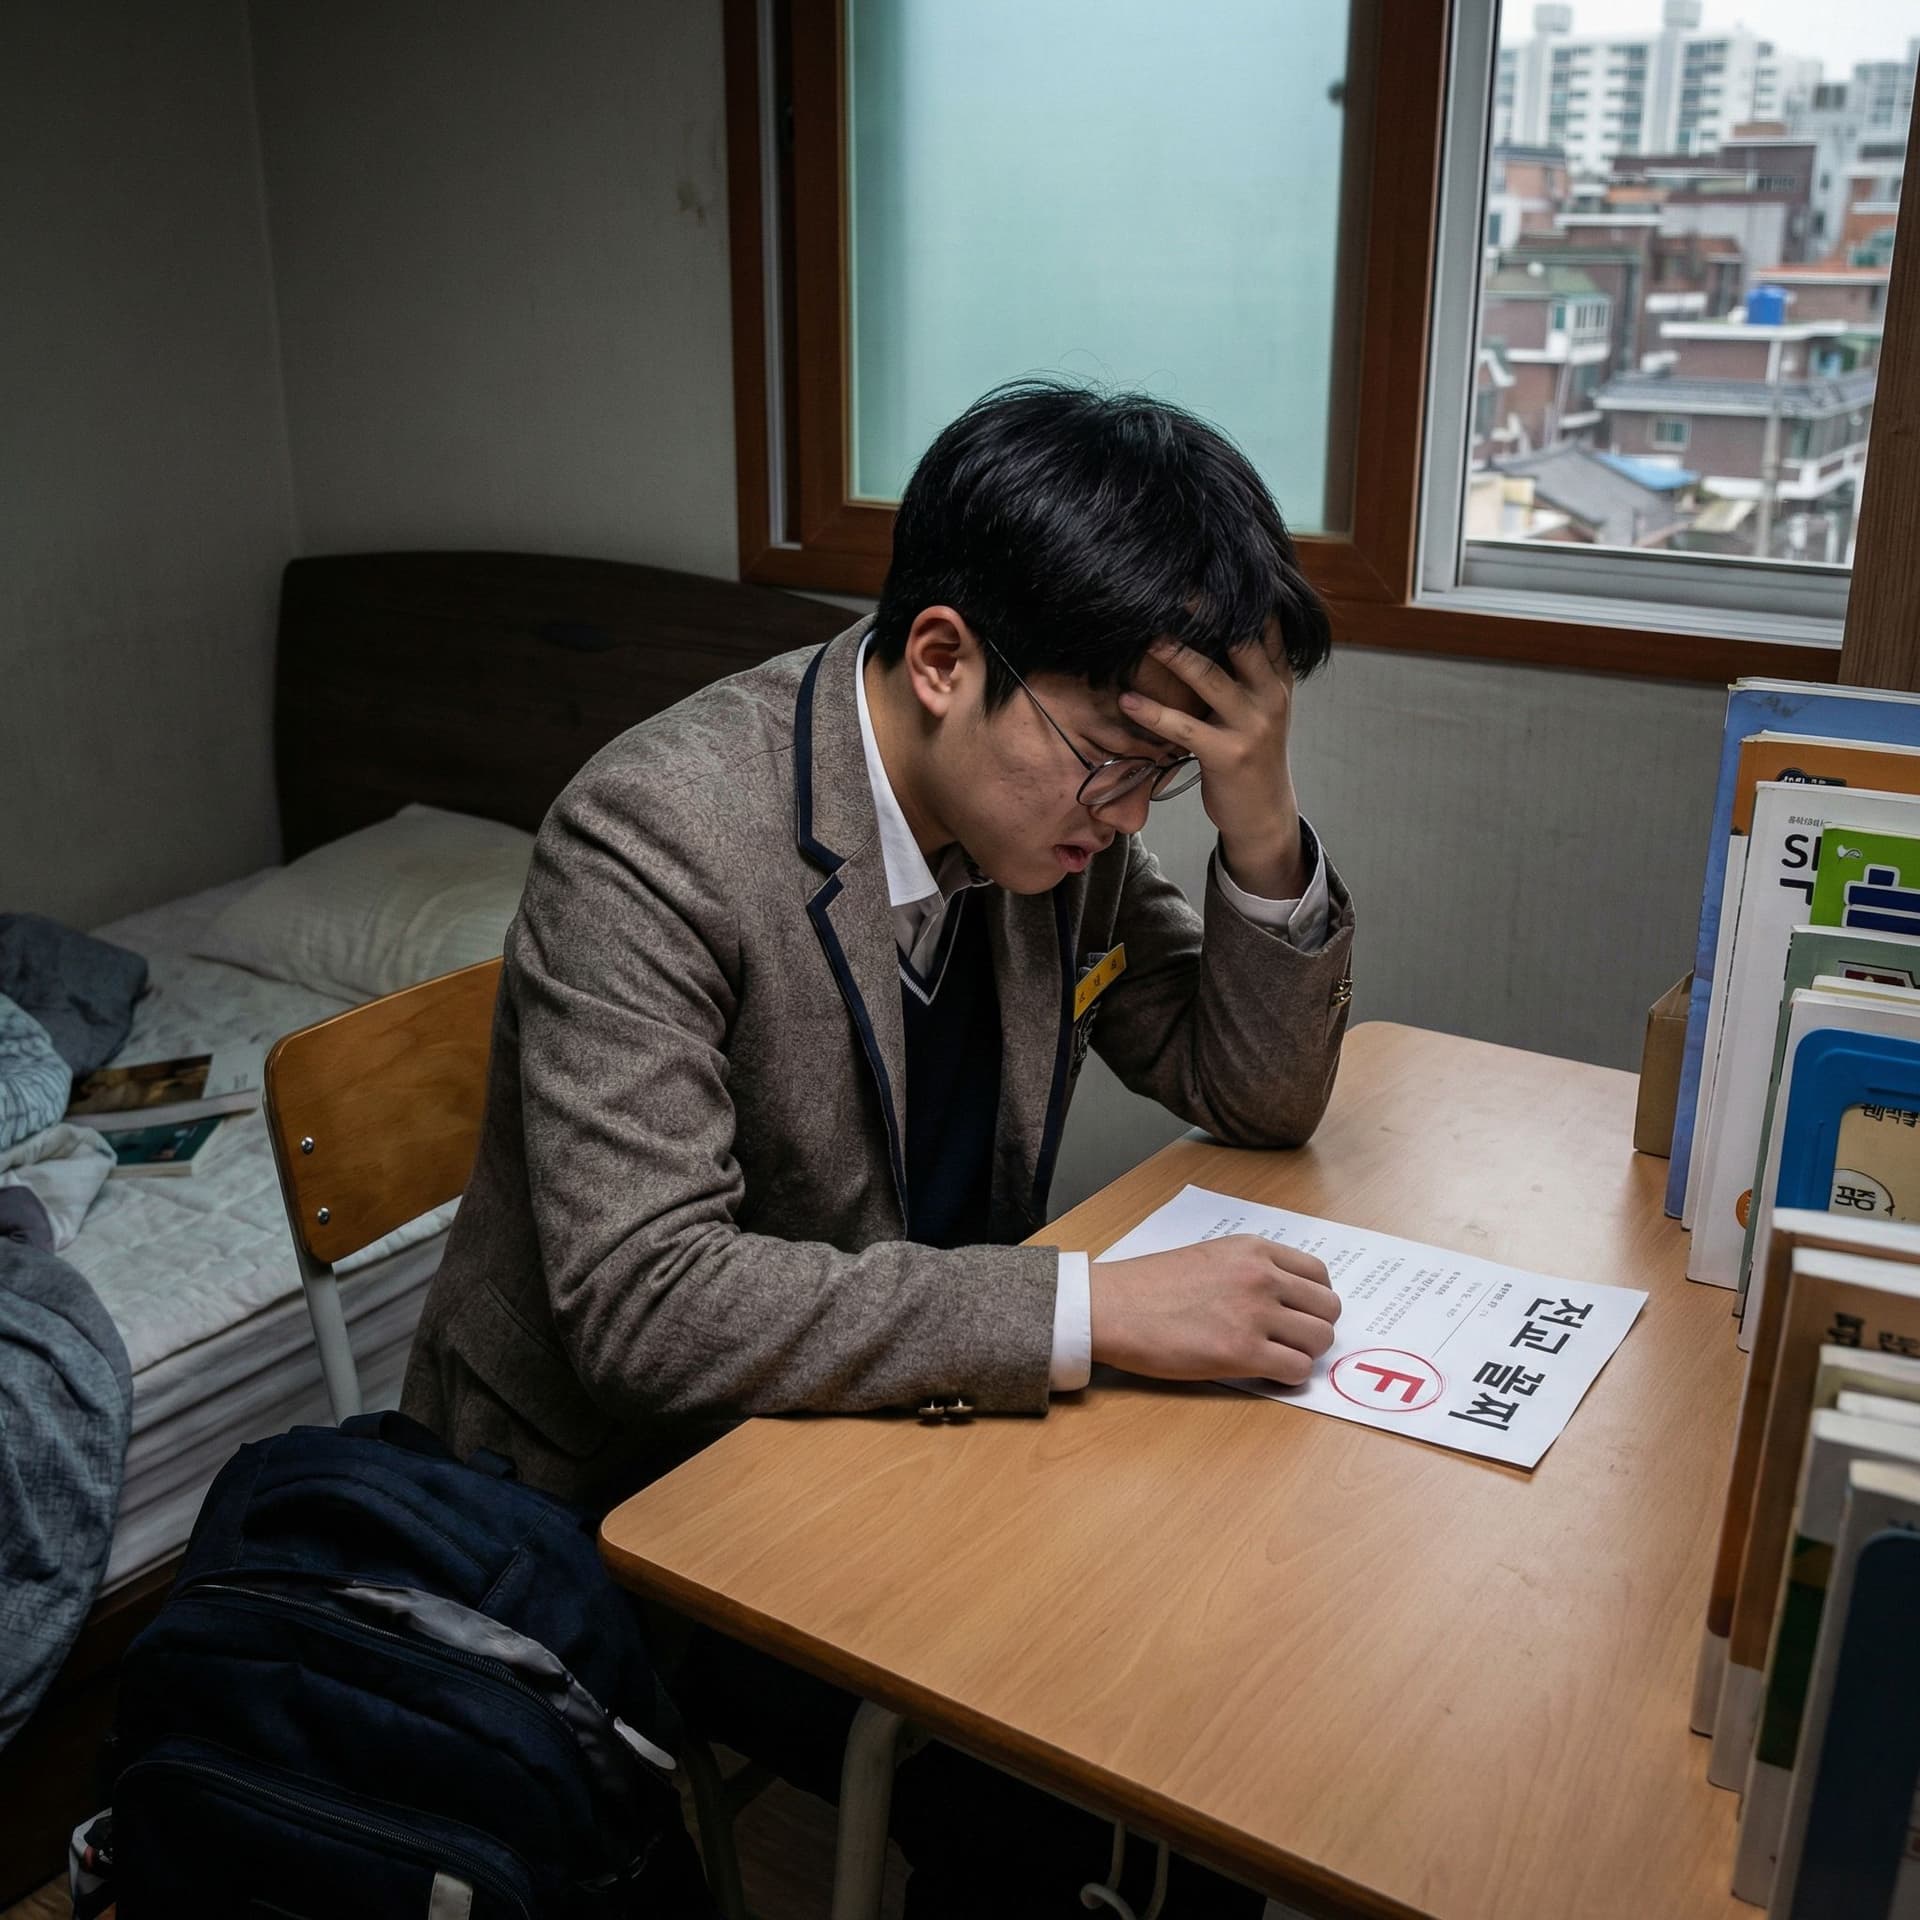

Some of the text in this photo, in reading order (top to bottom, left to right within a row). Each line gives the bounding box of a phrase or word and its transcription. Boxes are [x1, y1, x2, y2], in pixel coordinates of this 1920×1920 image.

[1509, 1298, 1594, 1355] 전교
[1353, 1362, 1426, 1404] F
[1448, 1361, 1546, 1431] 꼴찌
